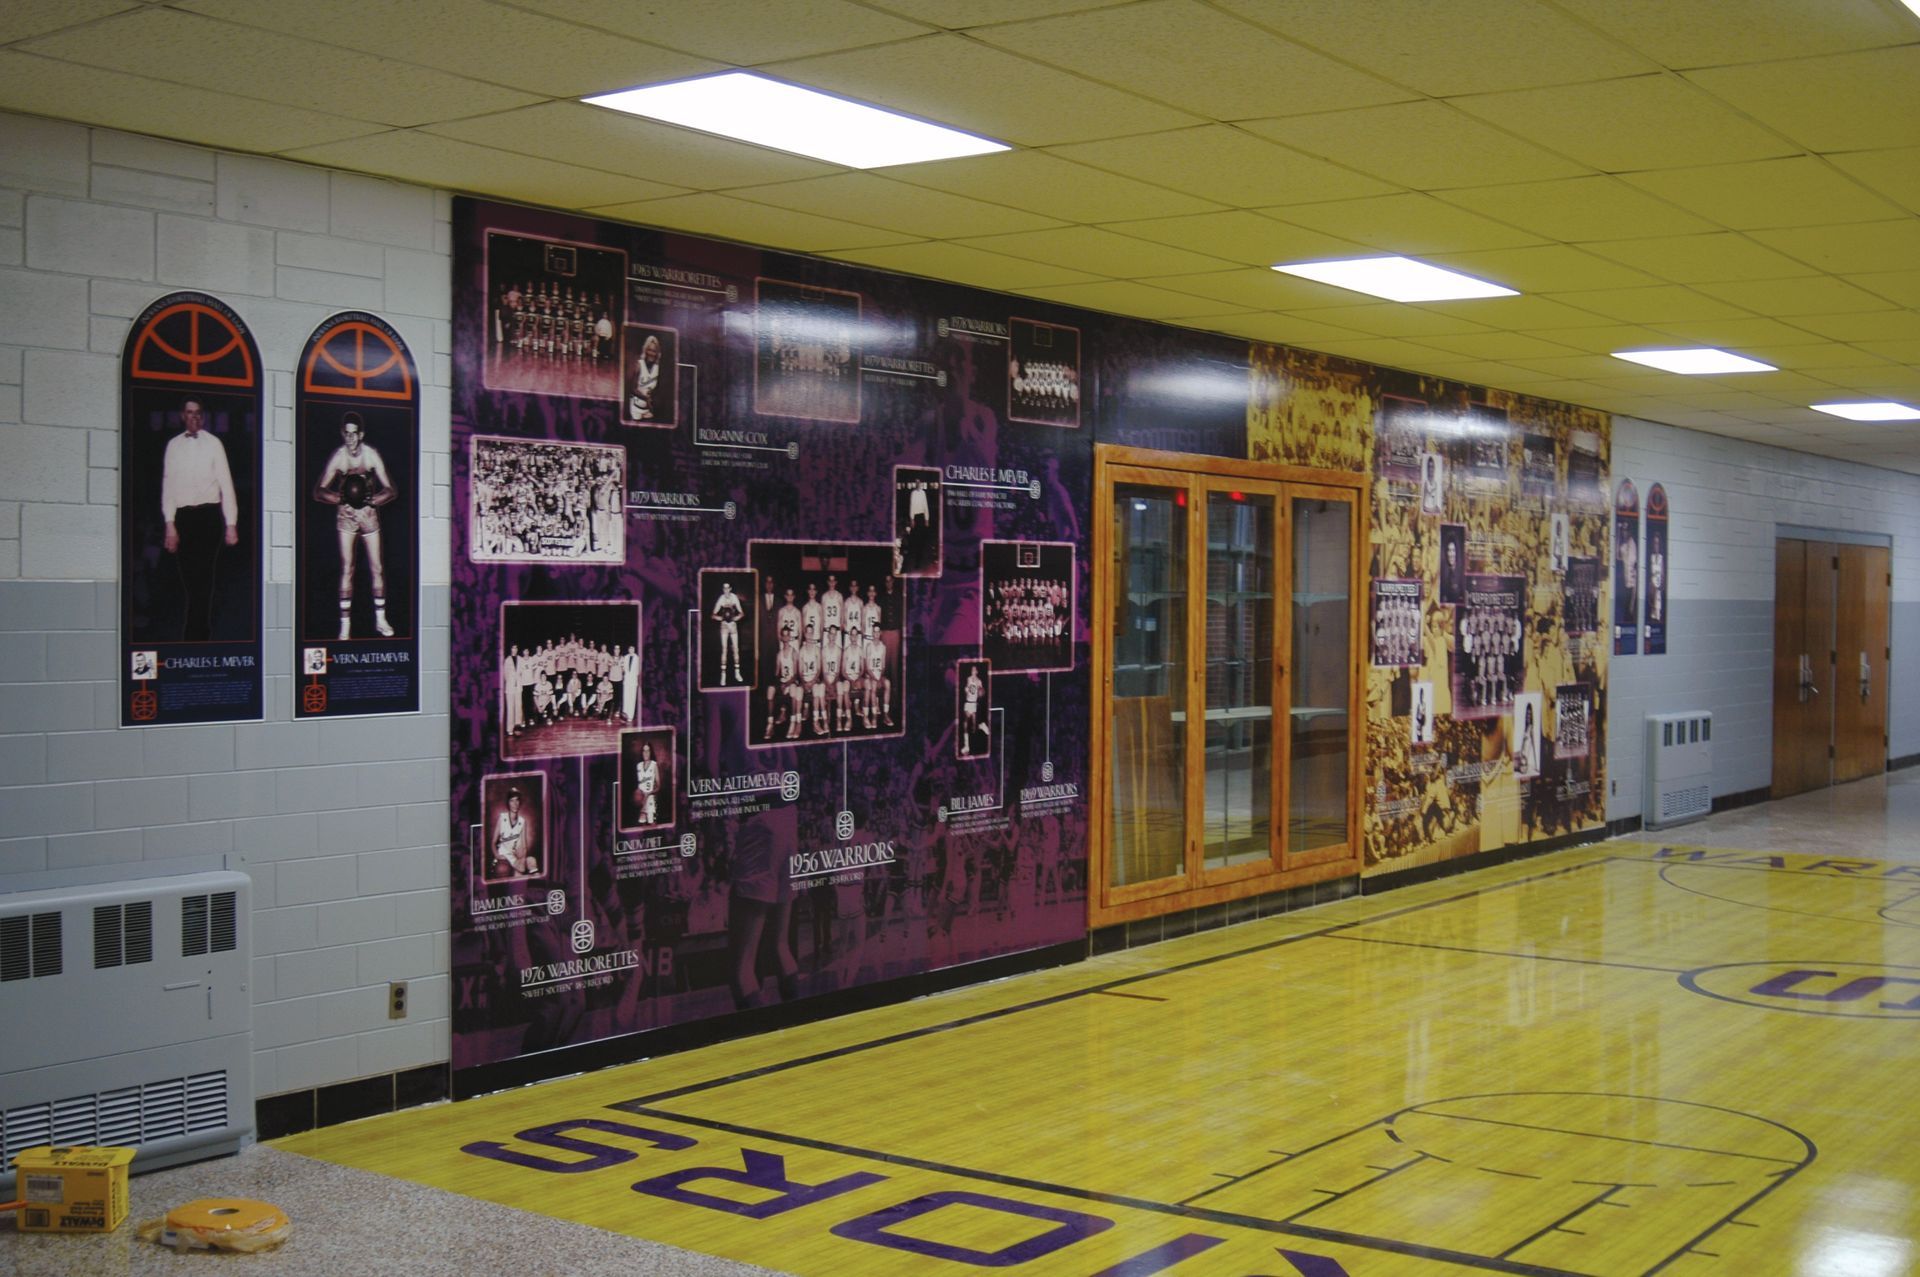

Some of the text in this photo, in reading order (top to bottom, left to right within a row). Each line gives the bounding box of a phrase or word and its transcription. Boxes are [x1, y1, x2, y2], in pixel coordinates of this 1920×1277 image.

[946, 464, 989, 481] CHARLES
[650, 491, 701, 506] WARRIORS
[165, 656, 212, 669] CHARLES
[333, 653, 359, 665] VERN
[690, 777, 722, 793] VERN
[950, 793, 995, 811] BILL JAMES
[788, 840, 895, 875] 1956 WARRIORS
[473, 893, 525, 912] PAM JONES
[520, 949, 640, 984] 1976 WARRIORETTES
